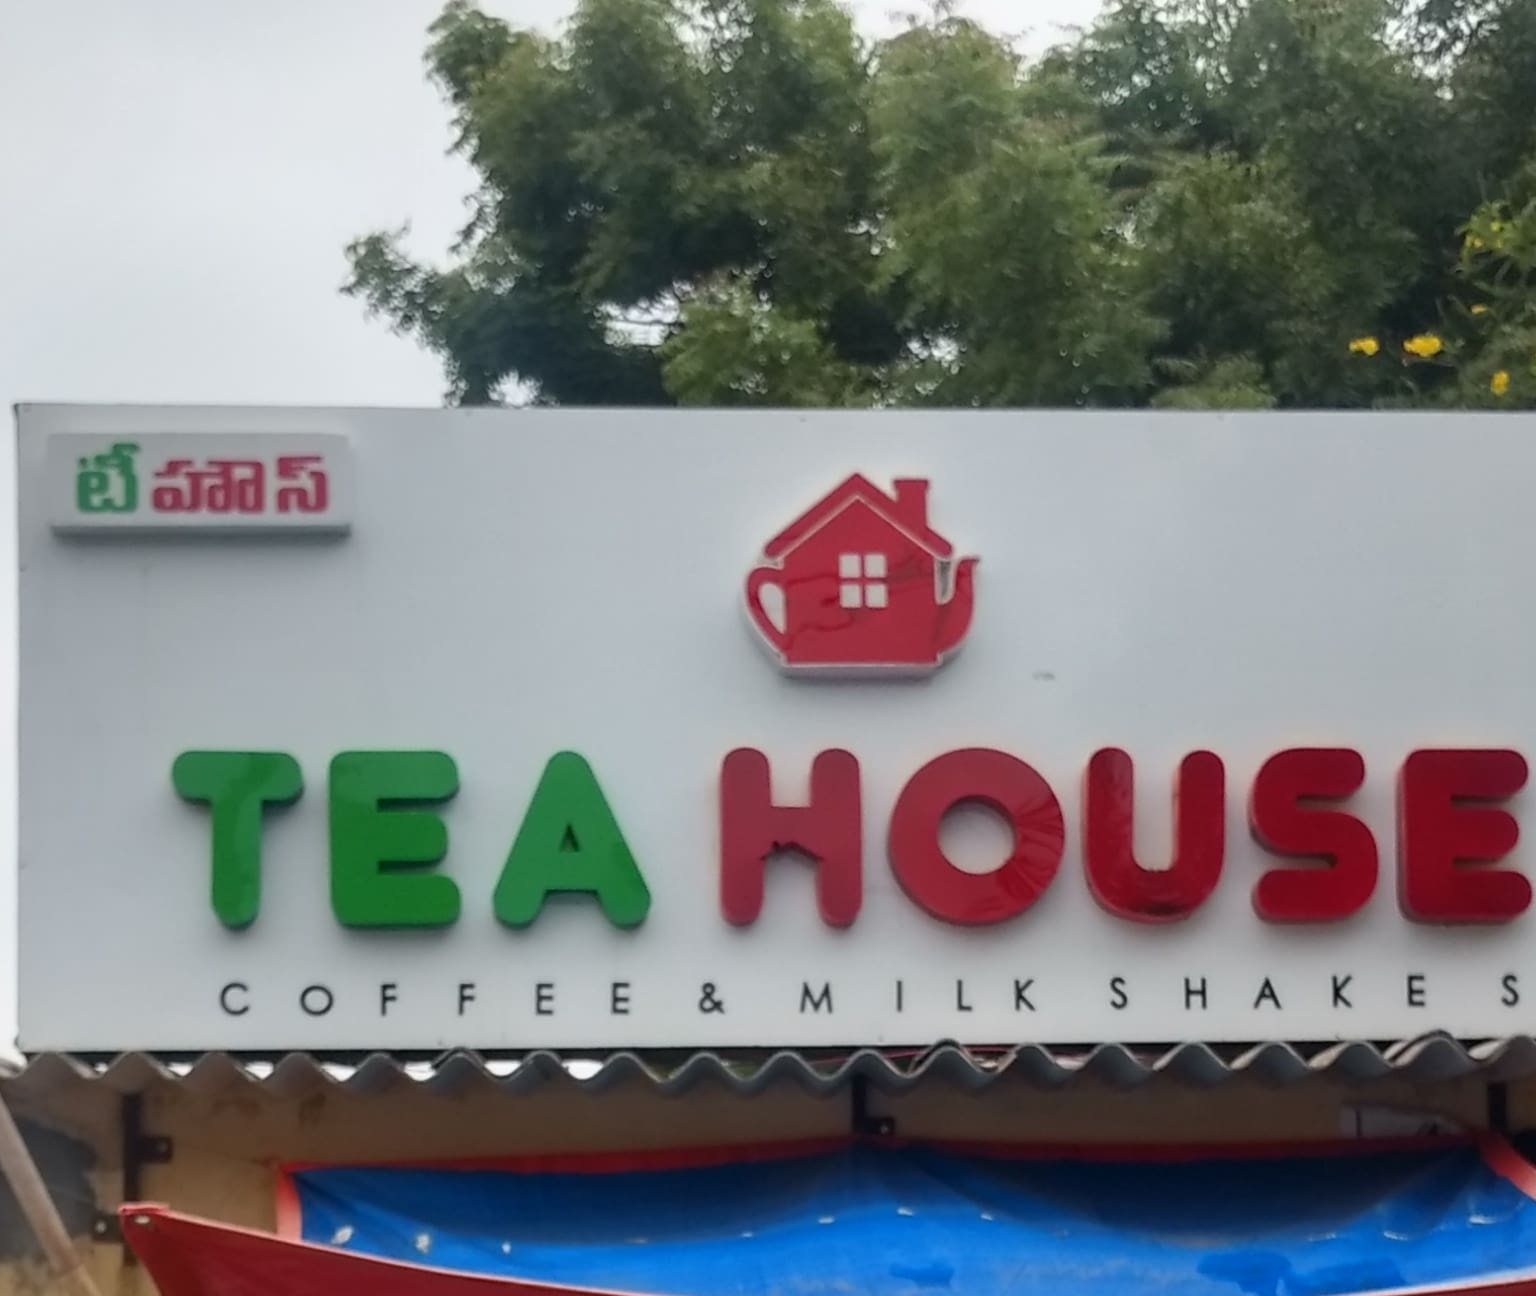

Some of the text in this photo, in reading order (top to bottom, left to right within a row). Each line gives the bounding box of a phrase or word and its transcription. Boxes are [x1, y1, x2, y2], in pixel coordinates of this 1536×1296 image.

[172, 746, 1534, 932] TEA HOUSE
[219, 973, 1520, 1017] COFFEE & MILK SHAKES
